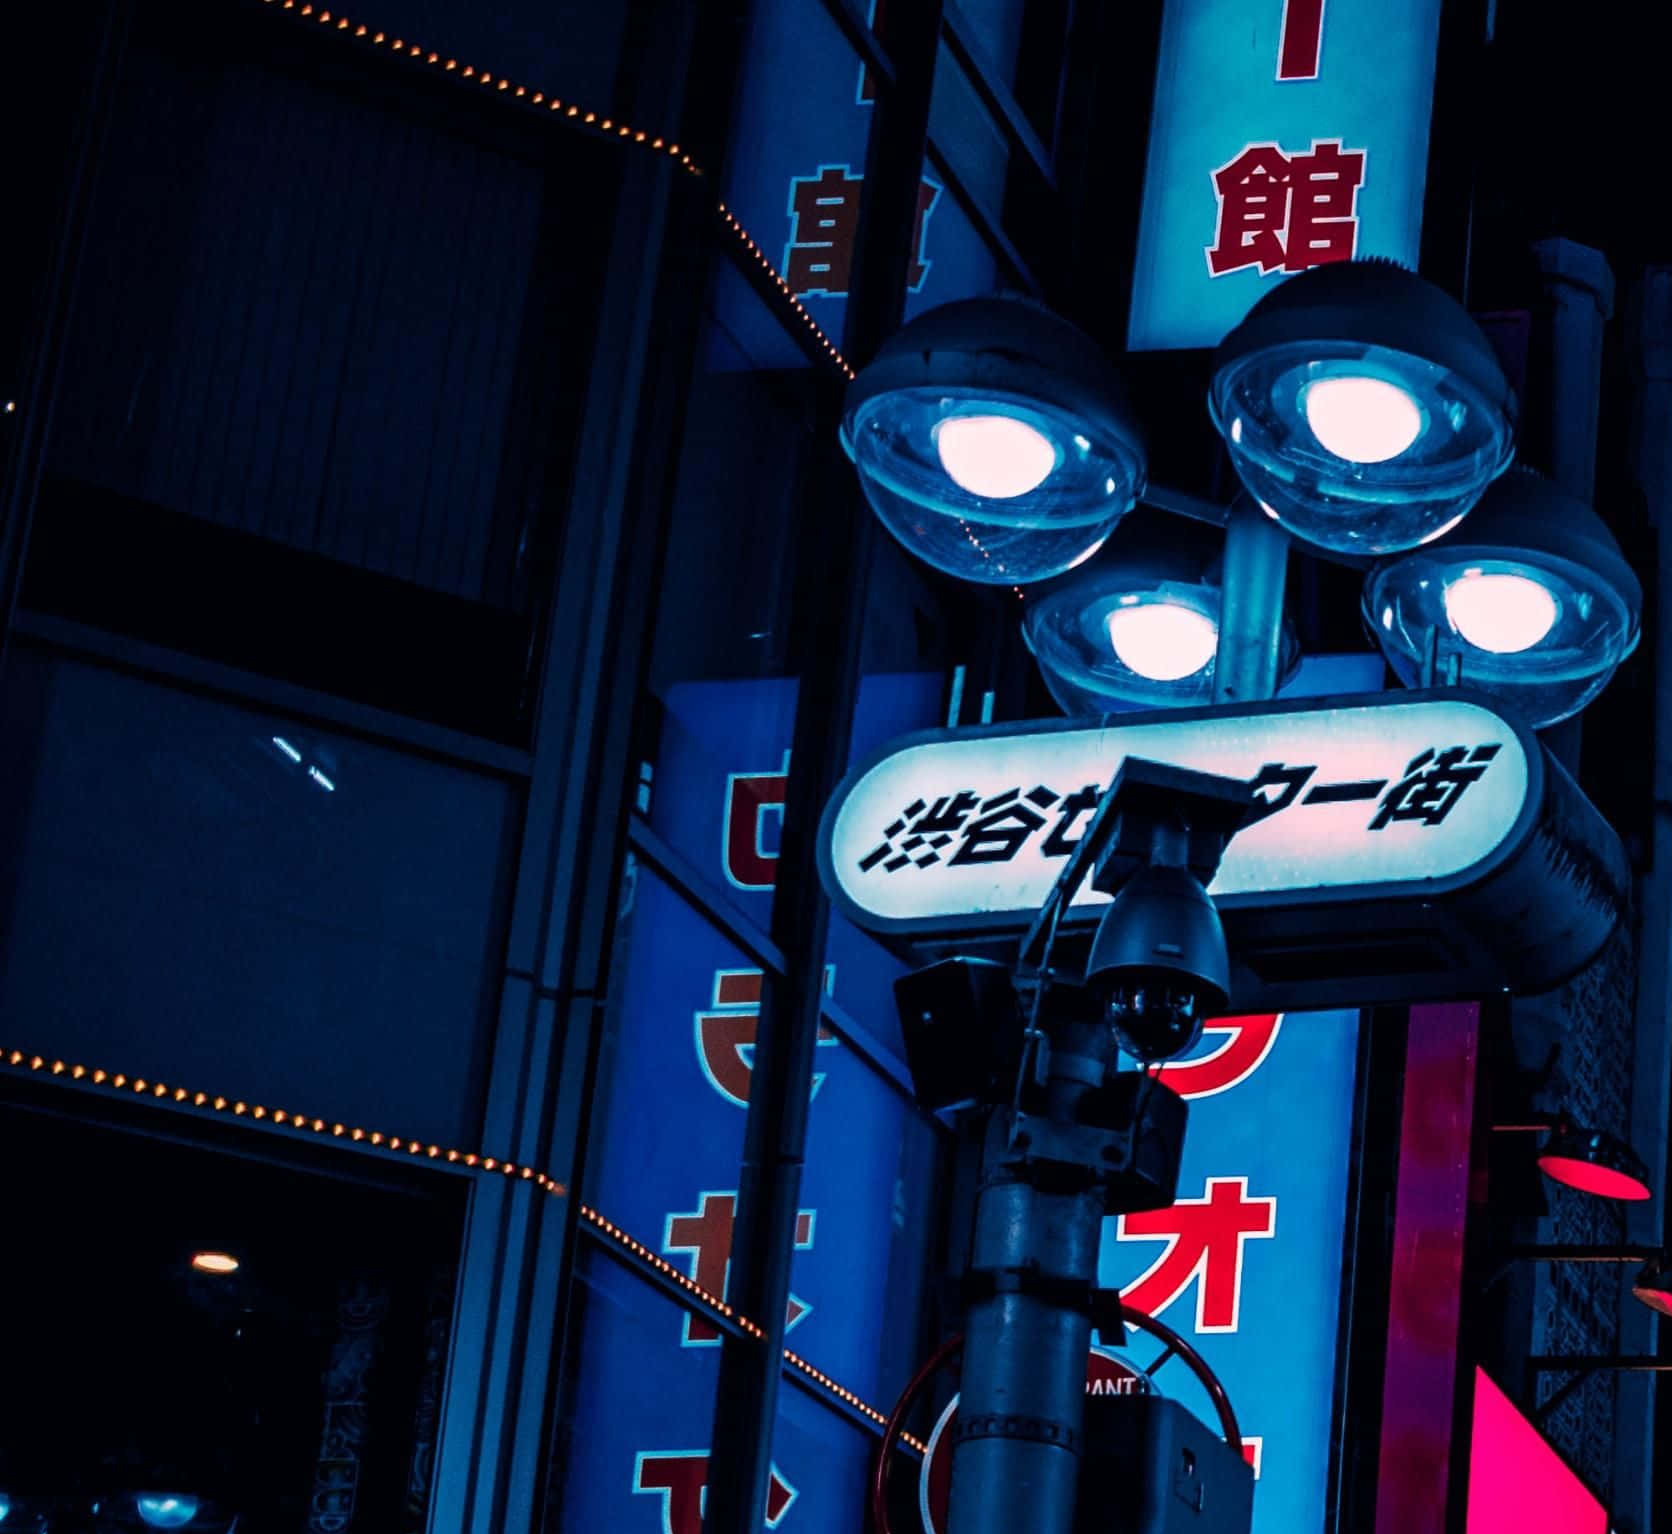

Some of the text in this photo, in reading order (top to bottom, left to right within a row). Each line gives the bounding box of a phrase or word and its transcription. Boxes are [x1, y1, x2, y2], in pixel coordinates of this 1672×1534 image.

[860, 744, 1502, 873] 渋谷セター街
